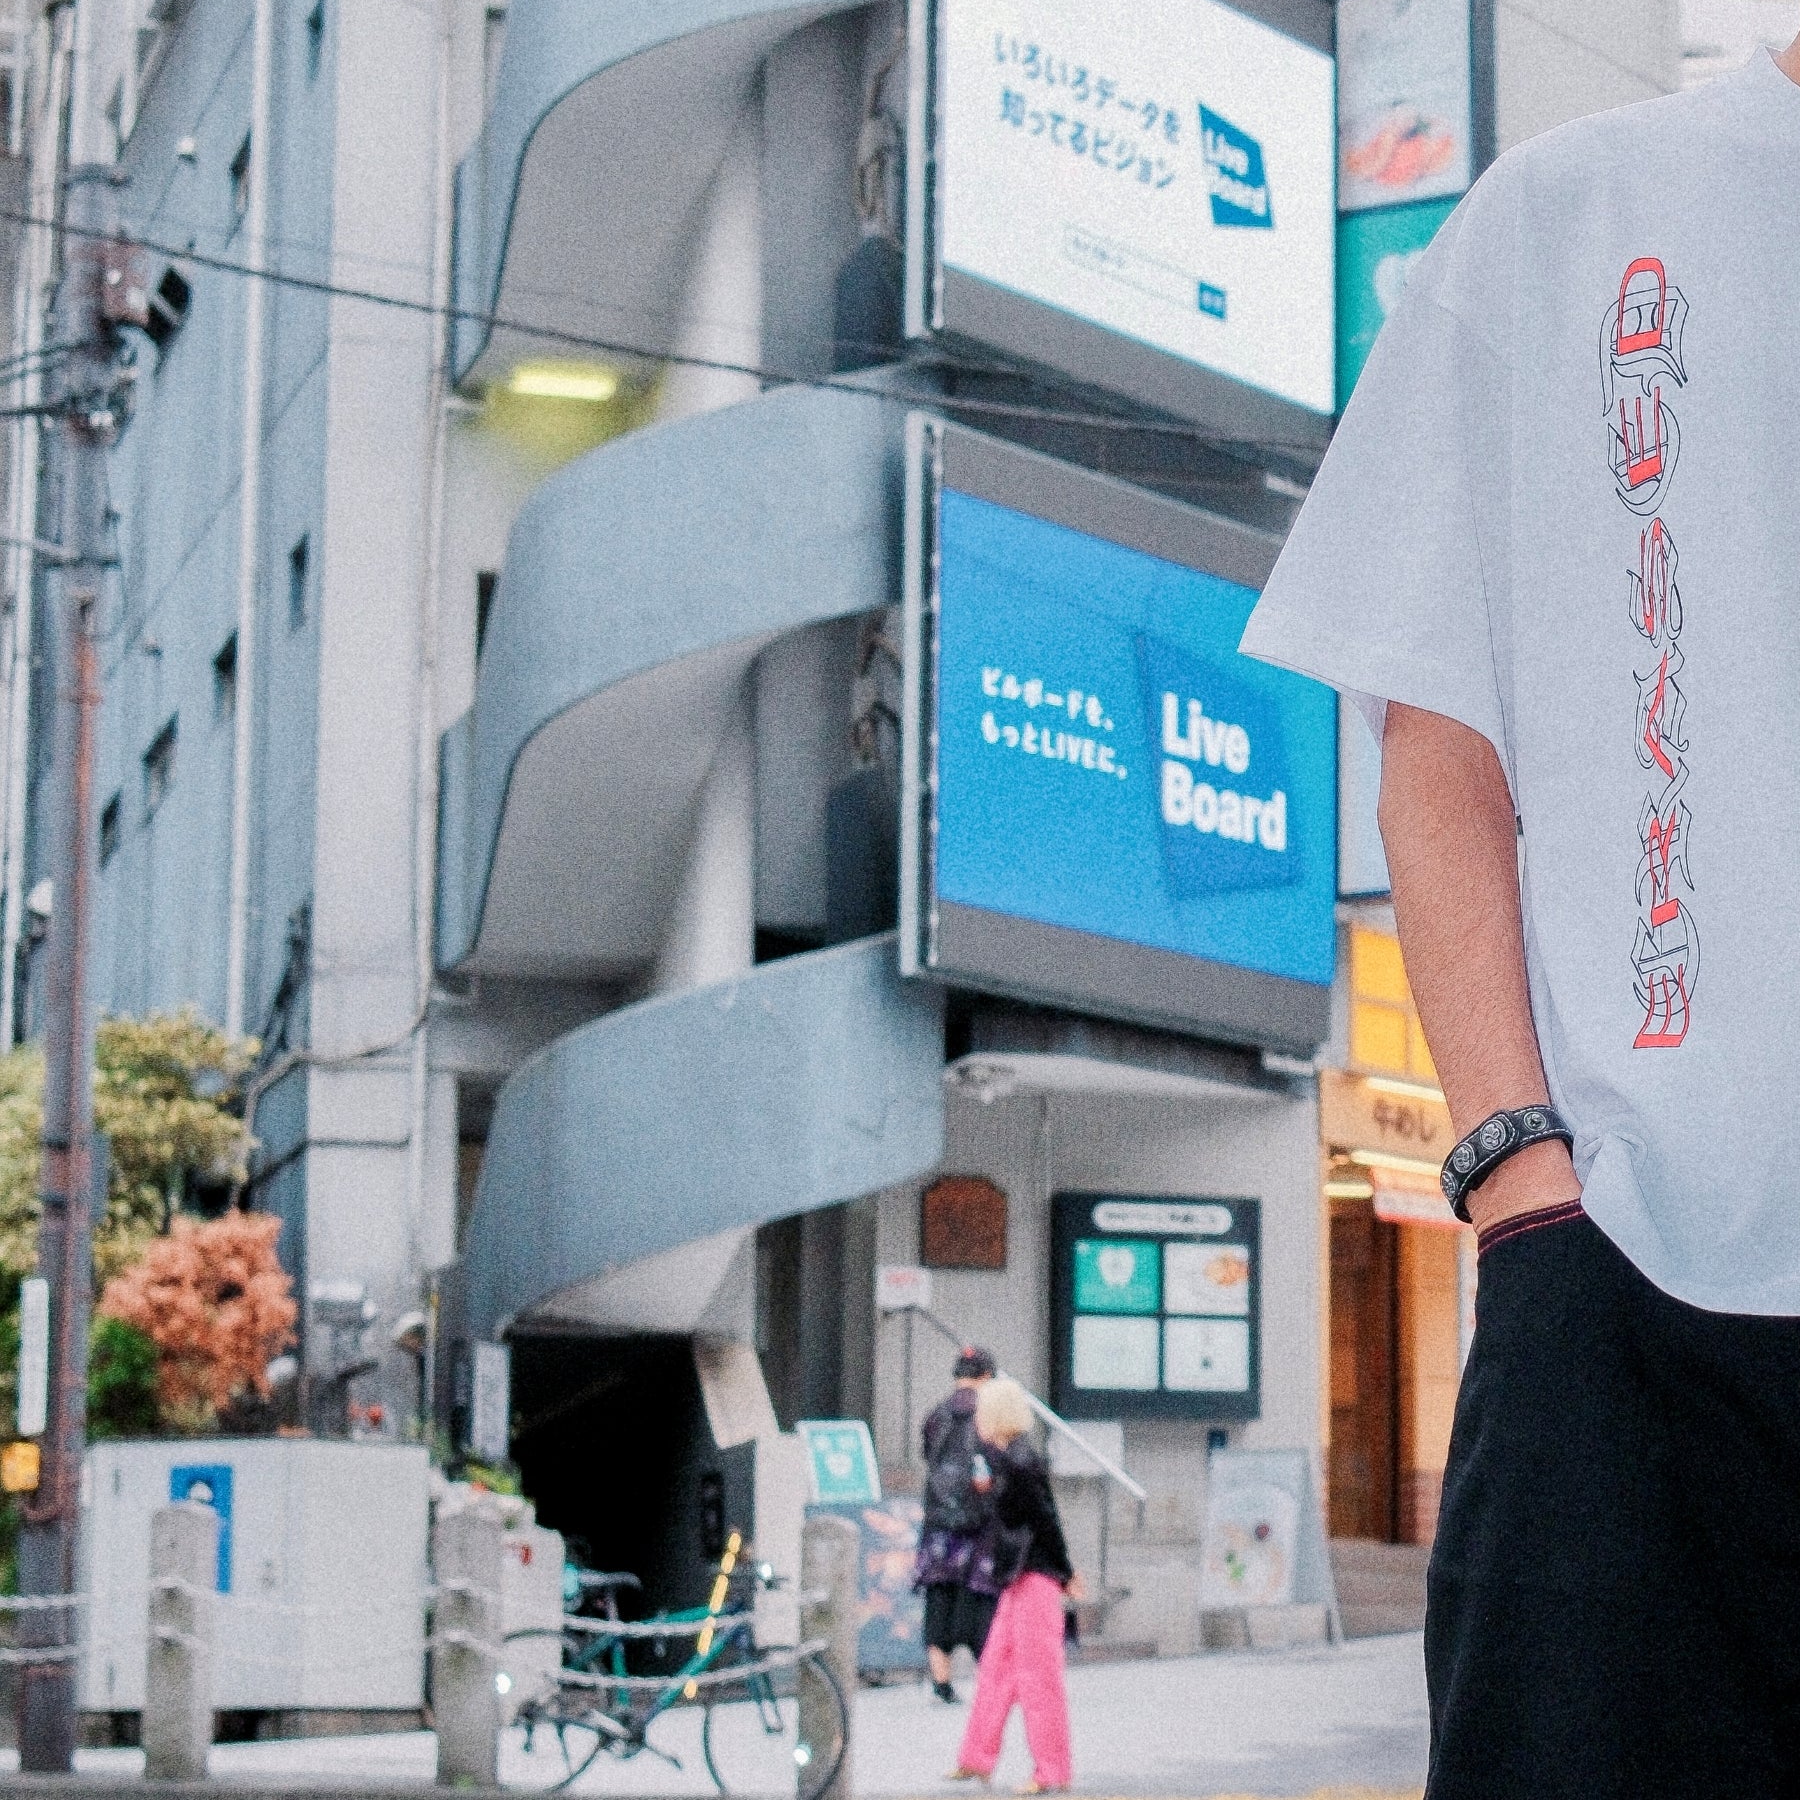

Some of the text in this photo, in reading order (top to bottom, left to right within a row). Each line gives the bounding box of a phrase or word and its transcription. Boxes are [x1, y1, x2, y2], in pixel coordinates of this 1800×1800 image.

[994, 31, 1181, 145] いろいろデータを
[999, 86, 1177, 189] 知ってるビジョン
[1161, 691, 1251, 774] Live
[1160, 761, 1288, 852] Board
